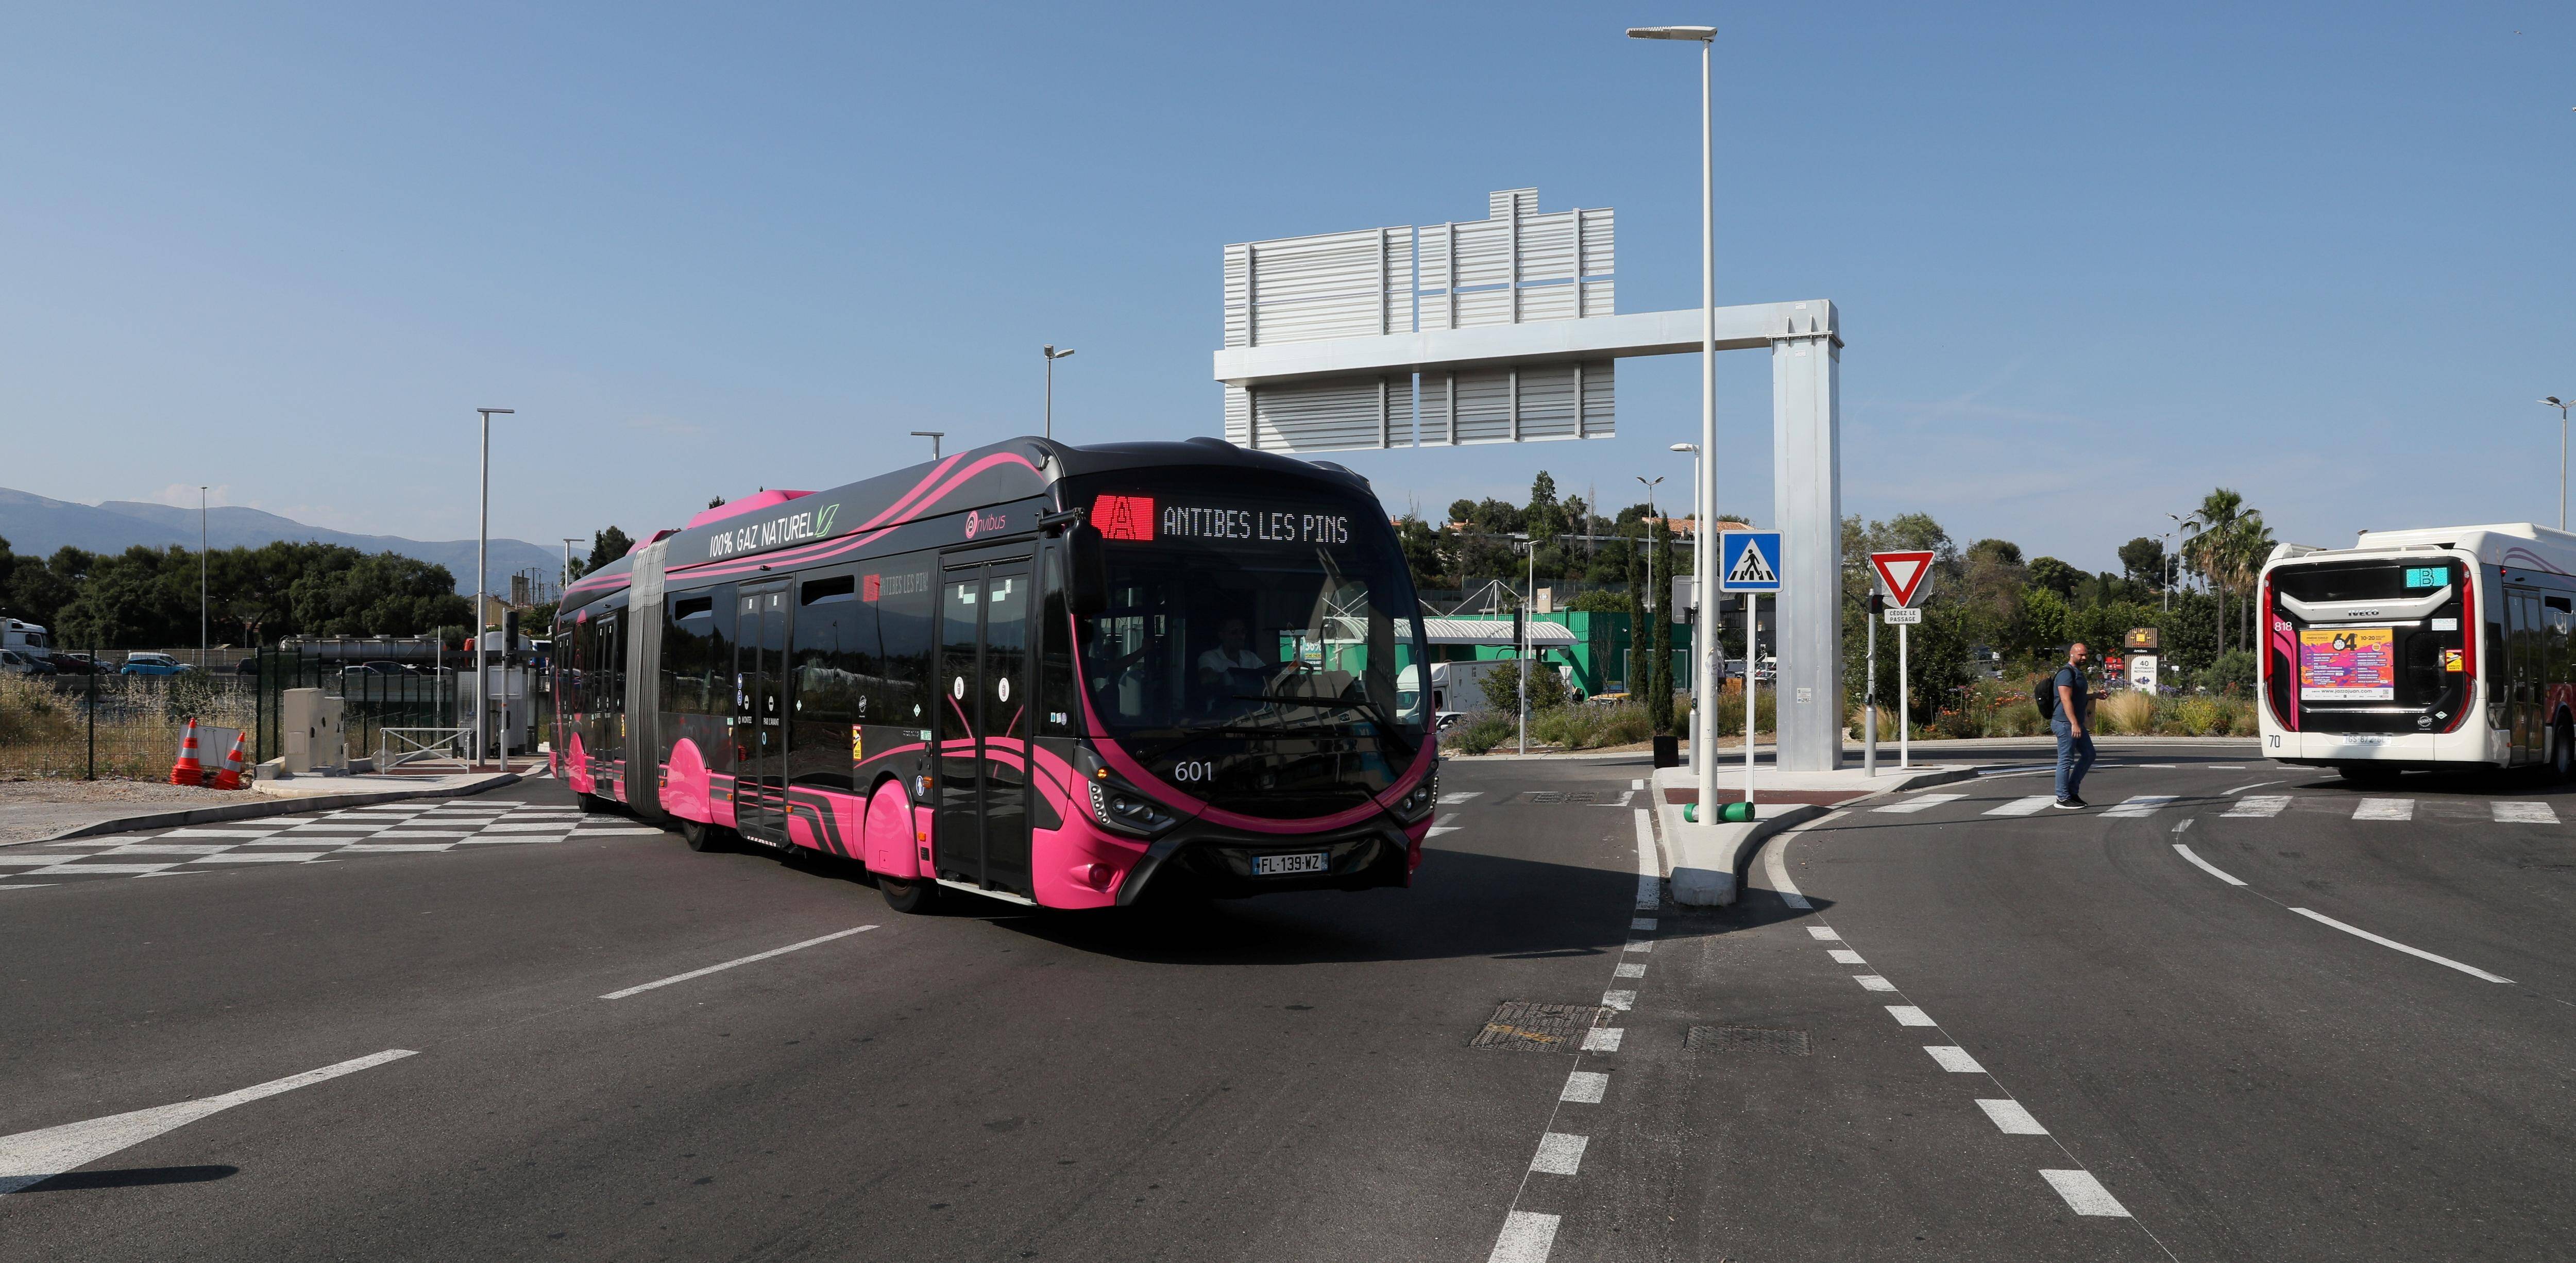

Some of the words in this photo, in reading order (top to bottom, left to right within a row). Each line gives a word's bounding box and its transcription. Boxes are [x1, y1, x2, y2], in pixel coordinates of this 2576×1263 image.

[966, 511, 1006, 537] envibus
[1107, 496, 1137, 540] A
[1163, 506, 1251, 538] ANTIBES
[1259, 512, 1295, 541] LES
[1303, 514, 1348, 544] PINS
[709, 531, 733, 558] 100%
[737, 525, 758, 552] GAZ
[761, 512, 814, 547] NATUREL
[879, 576, 903, 597] ANTIBES
[903, 574, 914, 594] LES
[2419, 568, 2435, 587] B
[2348, 609, 2379, 617] IVECO
[2274, 621, 2293, 632] 818
[2268, 735, 2281, 748] 70
[1174, 761, 1212, 782] 601
[1262, 853, 1319, 873] FL-139-WZ
